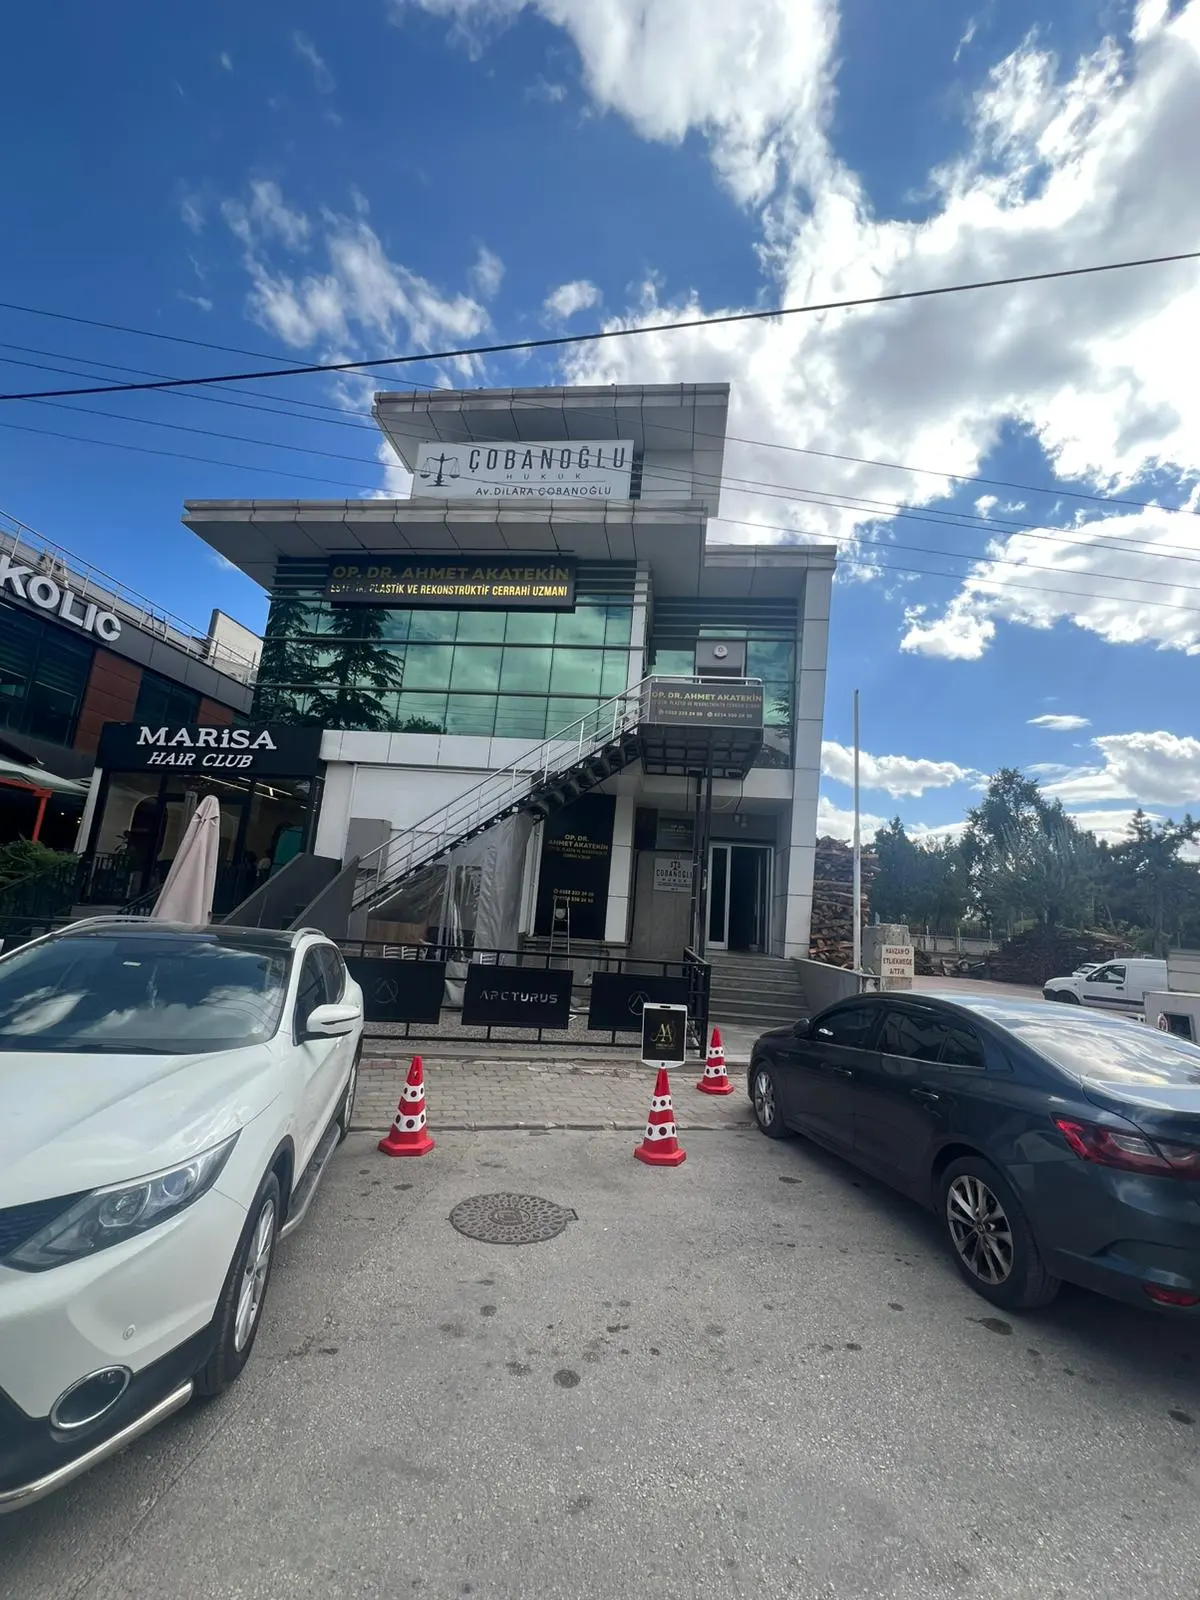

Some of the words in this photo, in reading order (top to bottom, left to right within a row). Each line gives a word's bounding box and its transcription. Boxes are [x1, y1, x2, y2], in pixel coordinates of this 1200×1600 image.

[468, 445, 625, 473] ÇOBANOĞLU
[332, 566, 362, 578] OP.
[367, 566, 397, 579] DR.
[401, 567, 469, 580] AHMET
[471, 564, 569, 581] AKATEKİN
[407, 584, 418, 594] VE
[420, 583, 490, 596] REKONSTRÜKTİF
[492, 584, 531, 596] CERRAHİ
[532, 586, 568, 597] UZMANI
[668, 692, 682, 700] DR.
[684, 693, 715, 701] AHMET
[717, 693, 762, 702] AKATEKİN
[202, 754, 253, 768] CLUB
[480, 990, 558, 1004] ARCTURUS
